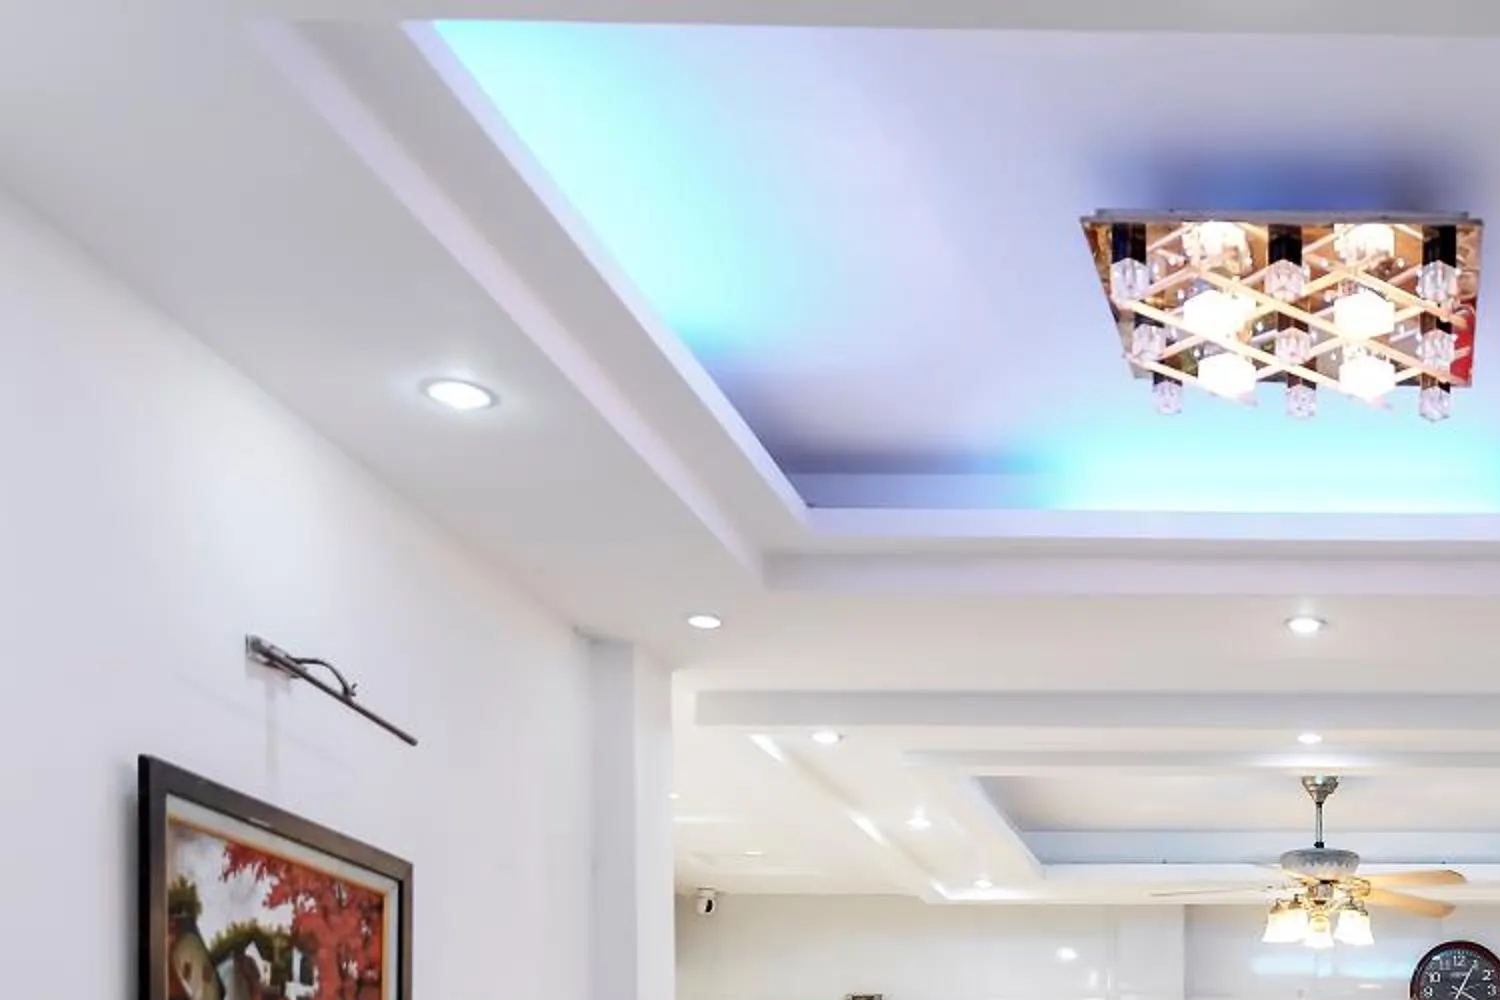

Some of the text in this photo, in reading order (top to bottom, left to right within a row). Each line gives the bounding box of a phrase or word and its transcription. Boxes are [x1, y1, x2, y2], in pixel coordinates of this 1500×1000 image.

[1453, 955, 1466, 966] 12
[1429, 971, 1440, 983] 10
[1482, 968, 1494, 981] 2
[1423, 985, 1433, 998] 9
[1487, 983, 1497, 996] 3
